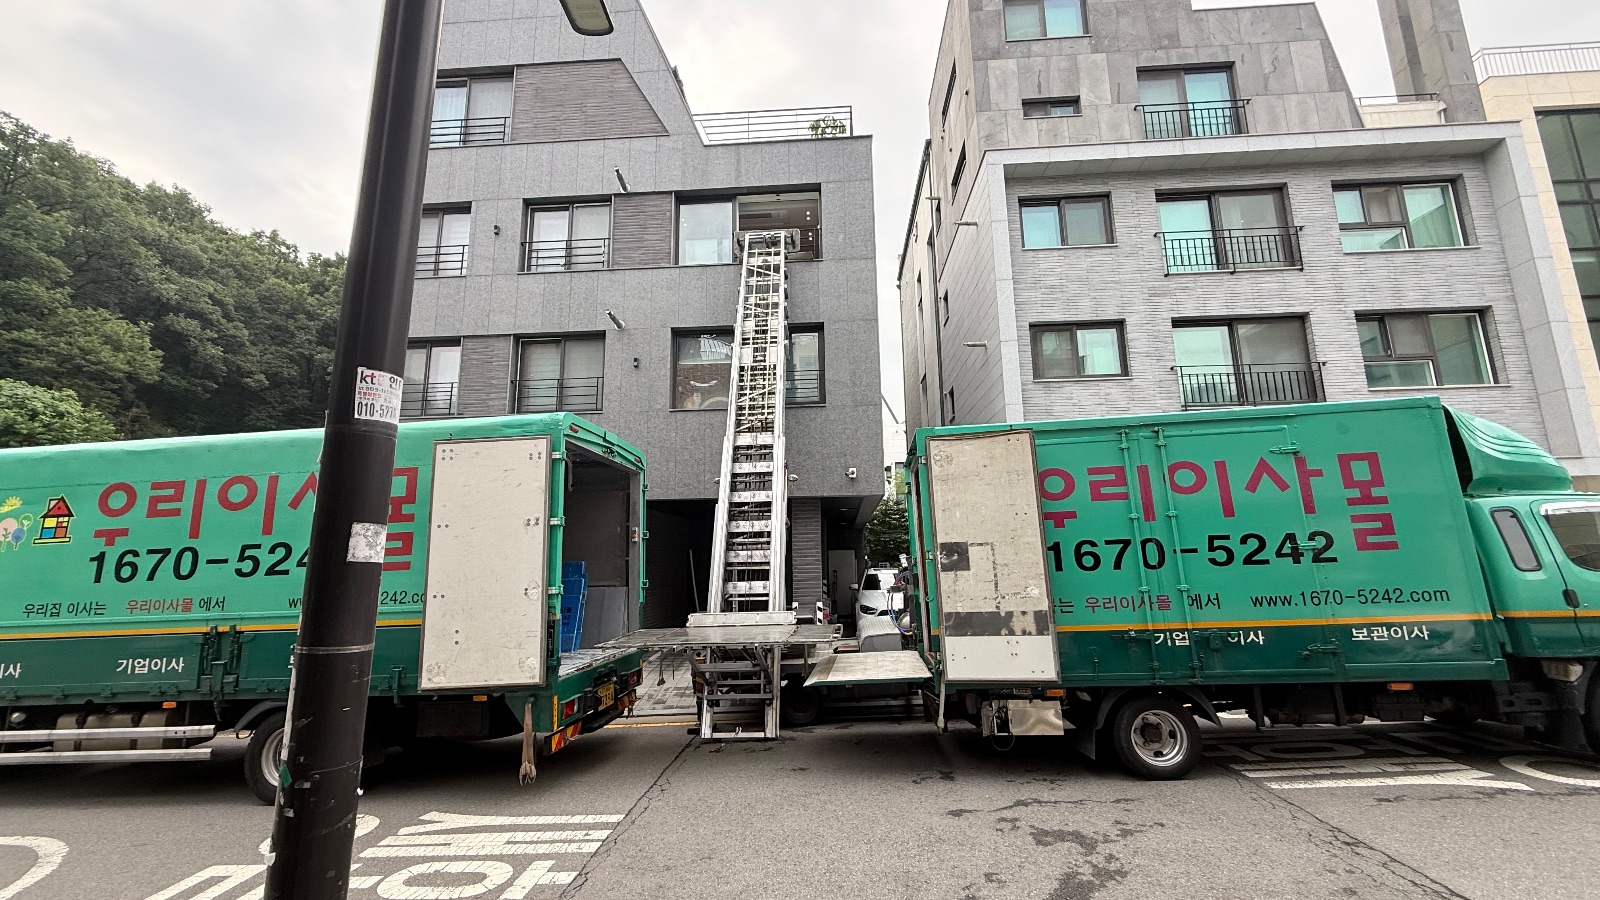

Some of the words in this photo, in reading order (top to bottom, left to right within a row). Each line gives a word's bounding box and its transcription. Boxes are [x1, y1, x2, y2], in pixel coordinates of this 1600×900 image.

[360, 371, 376, 385] kt
[1038, 451, 1399, 551] 우리이사몰
[1047, 530, 1338, 572] 1670-5242
[23, 602, 61, 618] 우리집
[67, 600, 107, 616] 이사는
[125, 598, 193, 615] 우리이사몰
[199, 596, 226, 611] 에서
[1084, 594, 1172, 614] 우리이사몰
[1187, 592, 1221, 610] 에서
[1250, 587, 1451, 609] www.1670-5242.com
[1351, 625, 1430, 642] 보관이사
[116, 657, 185, 674] 기업이사
